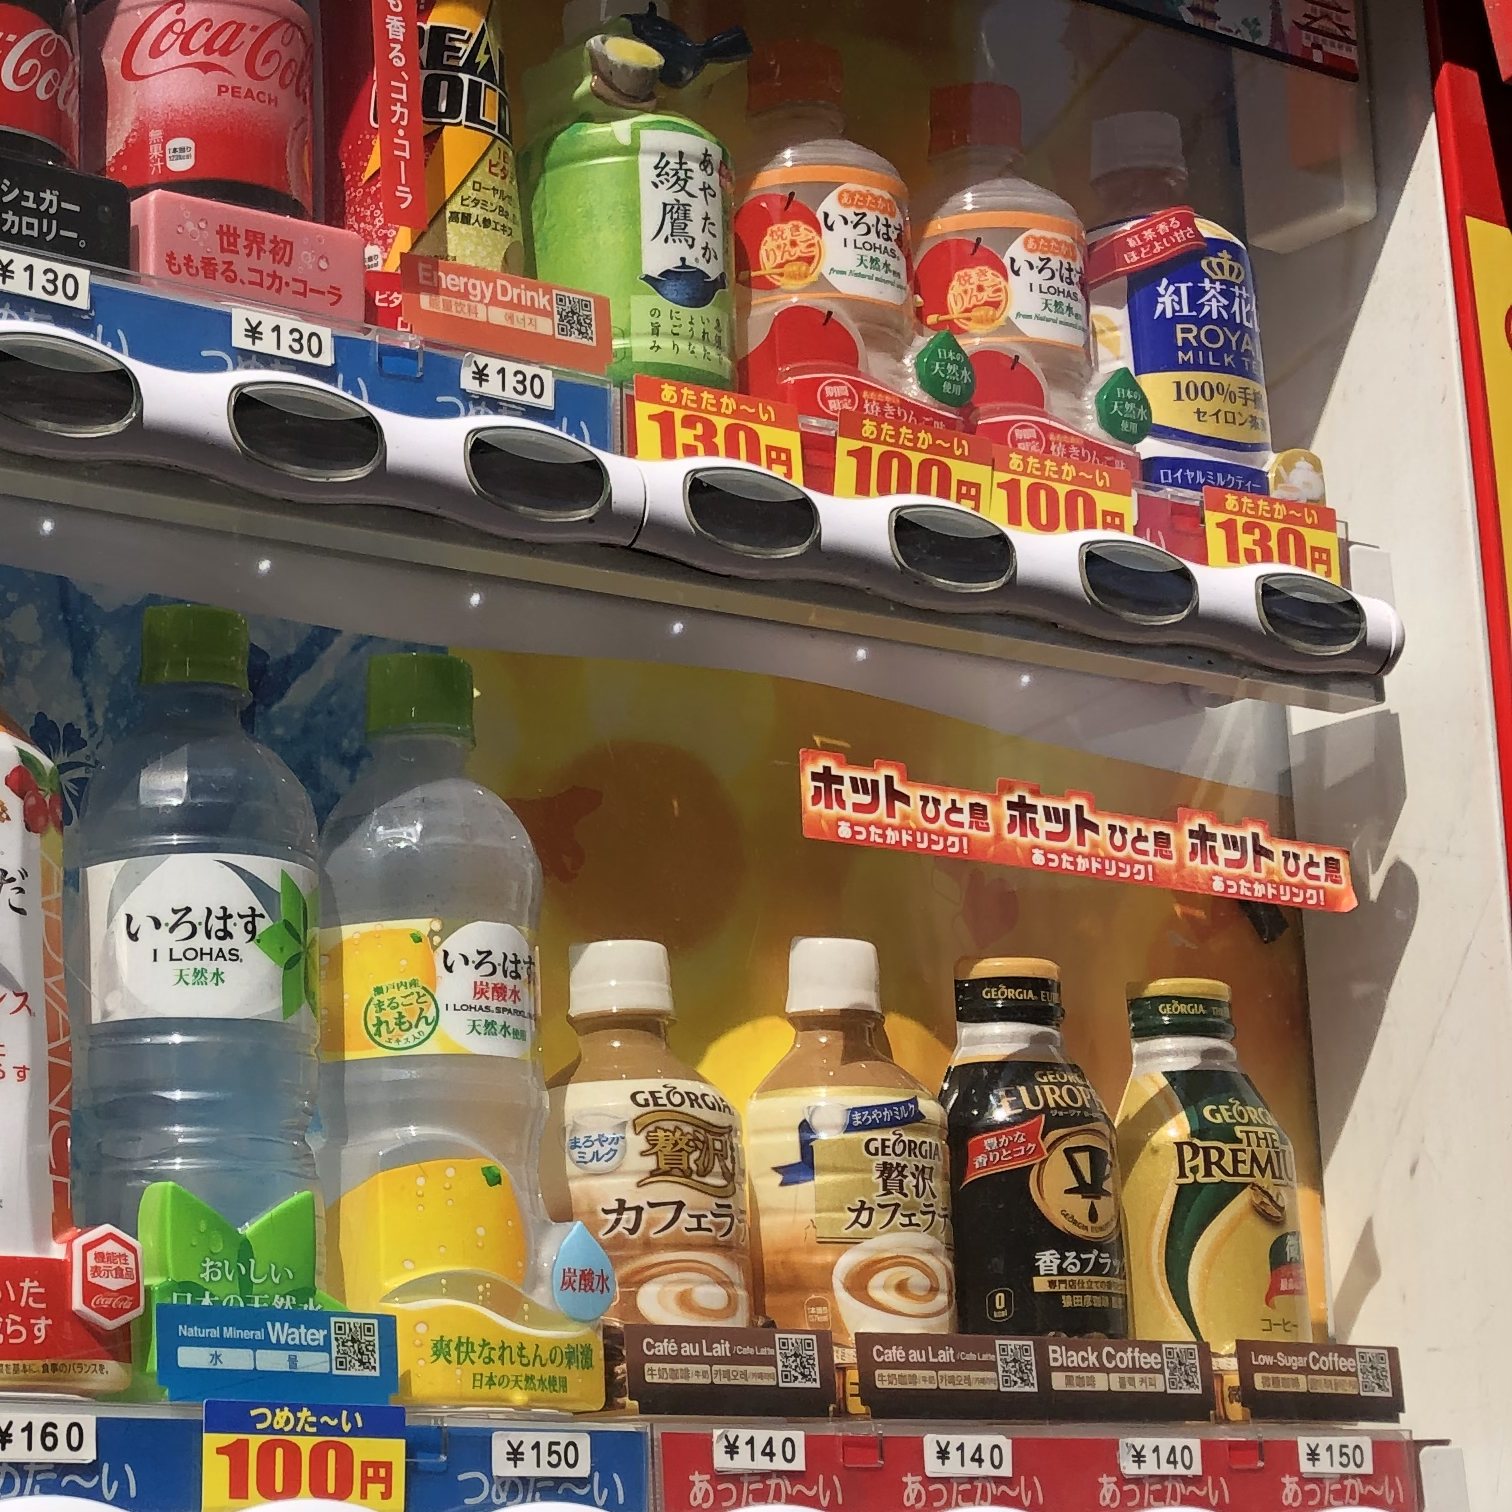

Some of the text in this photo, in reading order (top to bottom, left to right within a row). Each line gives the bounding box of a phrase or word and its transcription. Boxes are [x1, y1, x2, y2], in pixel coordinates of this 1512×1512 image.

[217, 84, 278, 107] PEACH
[149, 130, 164, 175] 無果汁
[650, 150, 698, 250] 綾鷹
[698, 147, 719, 265] あやたか
[1124, 227, 1196, 264] ほどよい甘さ
[1126, 217, 1181, 248] 紅茶香る
[215, 224, 295, 268] 世界初
[164, 249, 344, 308] もも香る、コカ・コーラ
[418, 262, 553, 312] Energy Drink
[243, 316, 324, 360] ¥130
[1177, 350, 1234, 369] MILK
[470, 361, 546, 400] ¥130
[929, 362, 972, 387] 天然水
[1109, 401, 1148, 422] 天然水
[1159, 468, 1262, 492] ロイヤルミルクティー
[171, 966, 226, 988] 天然水
[373, 991, 427, 1014] まるごと
[472, 980, 522, 1004] 炭酸水
[981, 983, 1036, 1001] GEORGIA
[372, 1007, 434, 1038] れもん
[630, 1084, 735, 1116] GEORGIA
[851, 1102, 919, 1126] まろやかミルク
[568, 1132, 626, 1150] まろやか
[863, 1130, 941, 1160] GEORGIA
[1239, 1130, 1279, 1149] THE
[575, 1147, 619, 1165] ミルク
[972, 1142, 1038, 1170] 香りとコク
[875, 1160, 938, 1200] 贅沢
[92, 1249, 131, 1266] 機能性
[88, 1264, 137, 1282] 表示食品
[199, 1257, 294, 1285] おいしい
[559, 1266, 610, 1294] 炭酸水
[177, 1322, 329, 1348] Natural Mineral Water
[642, 1338, 731, 1357] Café au Lait
[208, 1351, 224, 1366] 水
[429, 1334, 596, 1372] 爽快なれもんの刺激
[872, 1344, 955, 1364] Café au Lait
[1049, 1345, 1162, 1370] Black Coffee
[1251, 1351, 1357, 1372] Low-Sugar Coffee
[470, 1370, 569, 1394] 日本の天然水使用
[506, 1442, 579, 1469] ¥150
[724, 1435, 796, 1464] ¥140
[936, 1440, 1003, 1469] ¥140
[1131, 1444, 1194, 1470] ¥140
[1306, 1443, 1364, 1468] ¥150
[216, 1439, 393, 1501] 100円
